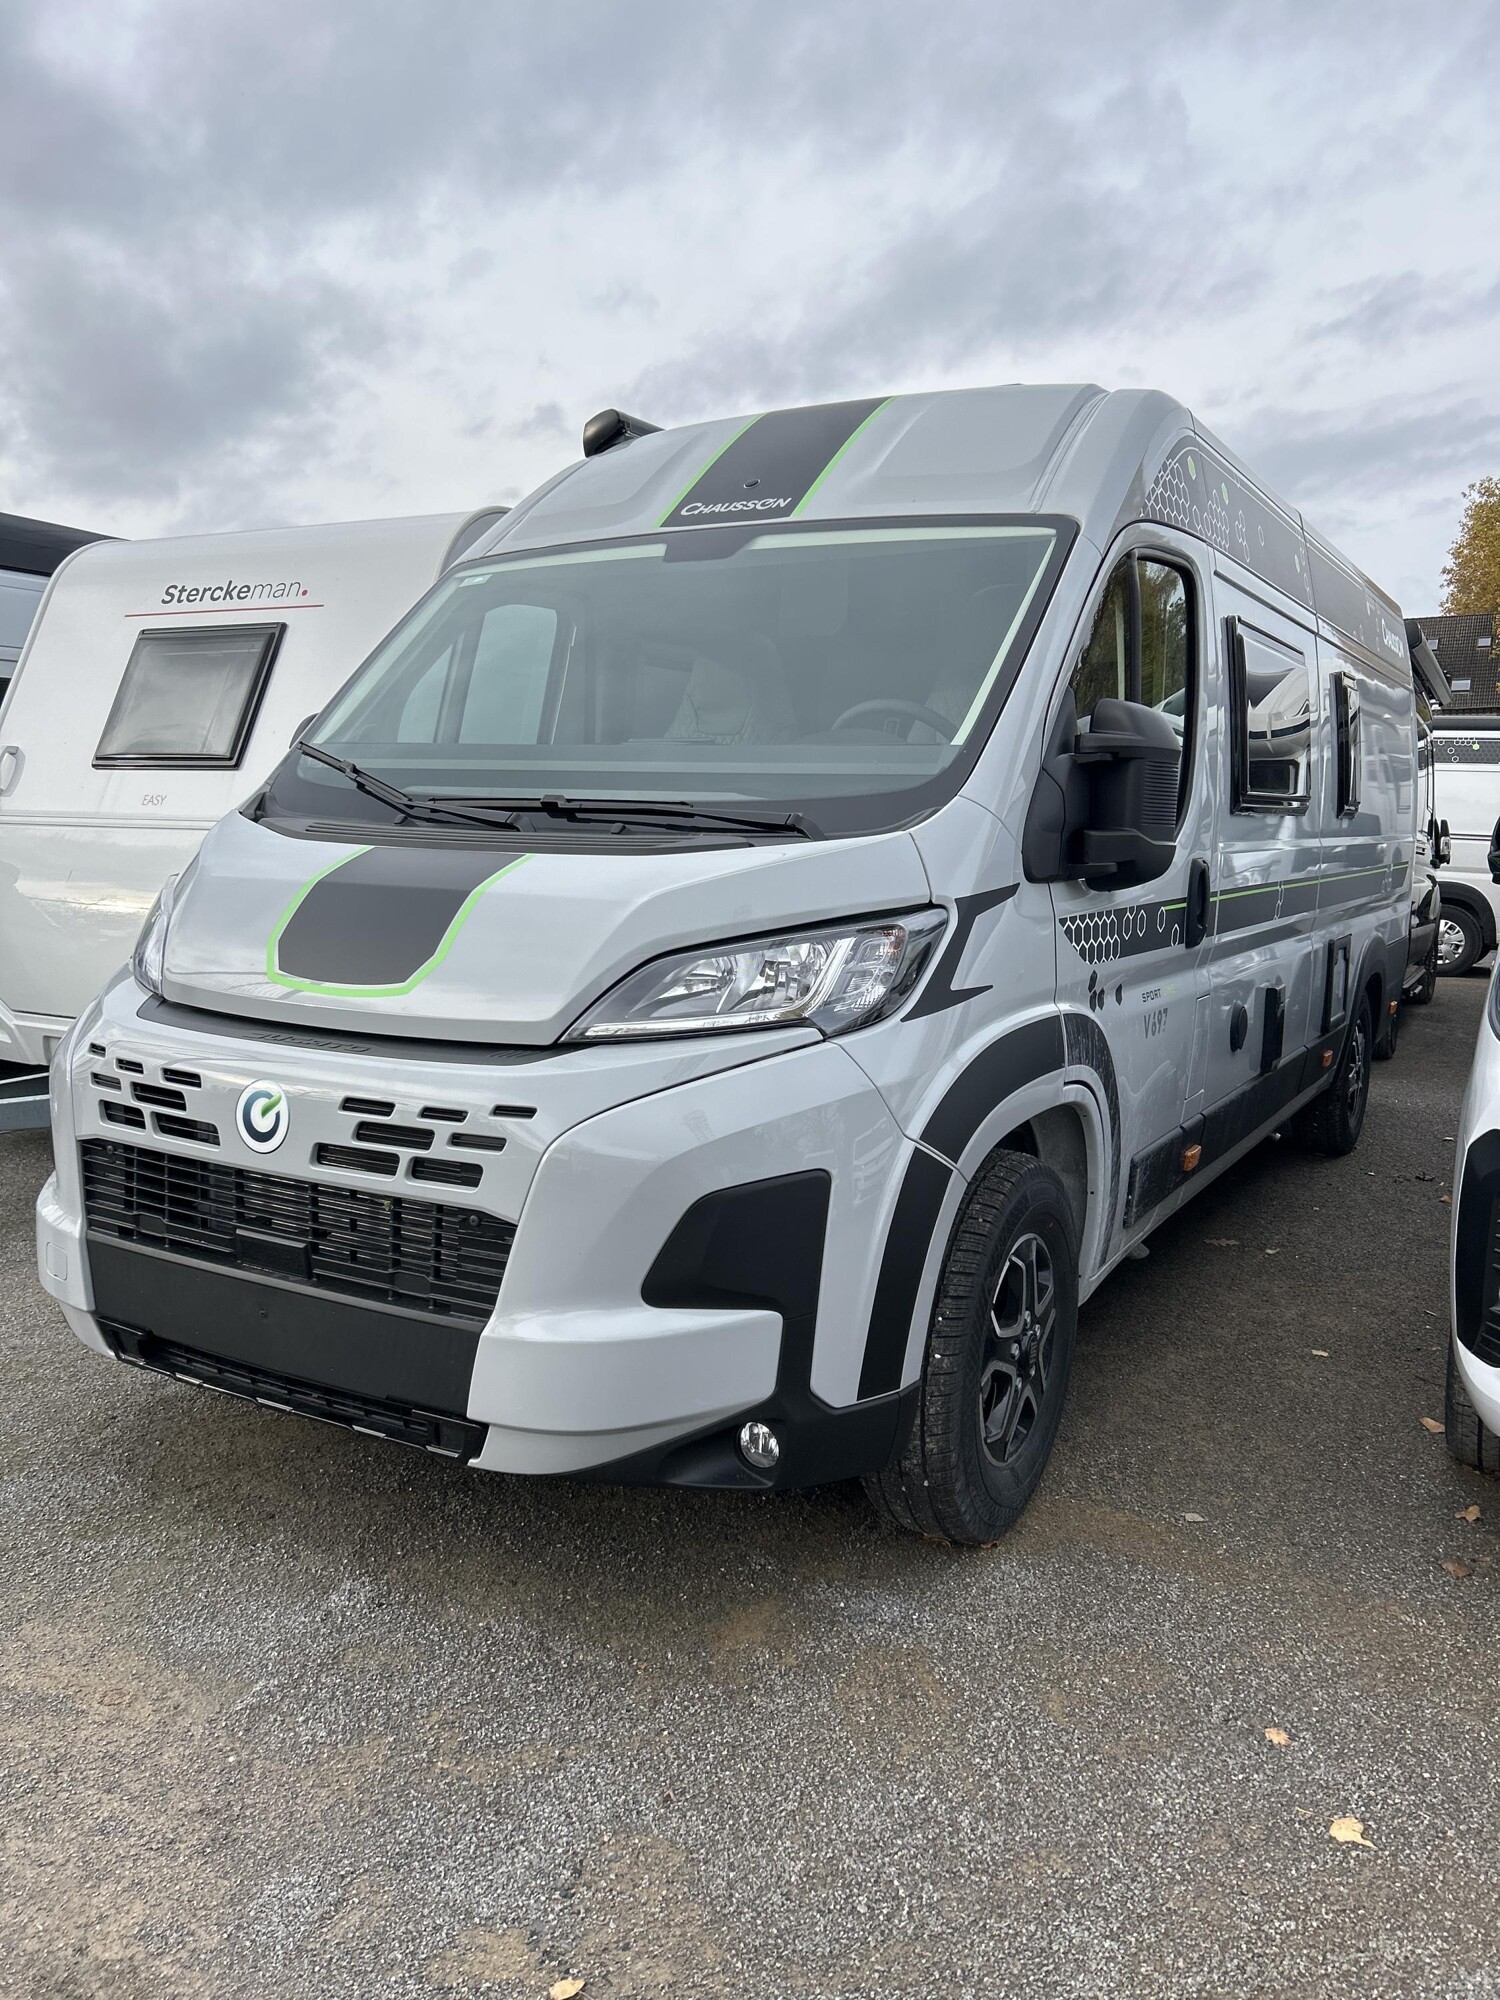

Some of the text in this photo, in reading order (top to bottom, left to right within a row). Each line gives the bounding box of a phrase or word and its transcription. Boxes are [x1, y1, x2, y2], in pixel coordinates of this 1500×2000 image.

[680, 497, 792, 516] CHAUSSON
[141, 794, 168, 806] EASY
[1141, 988, 1162, 1003] SPORT
